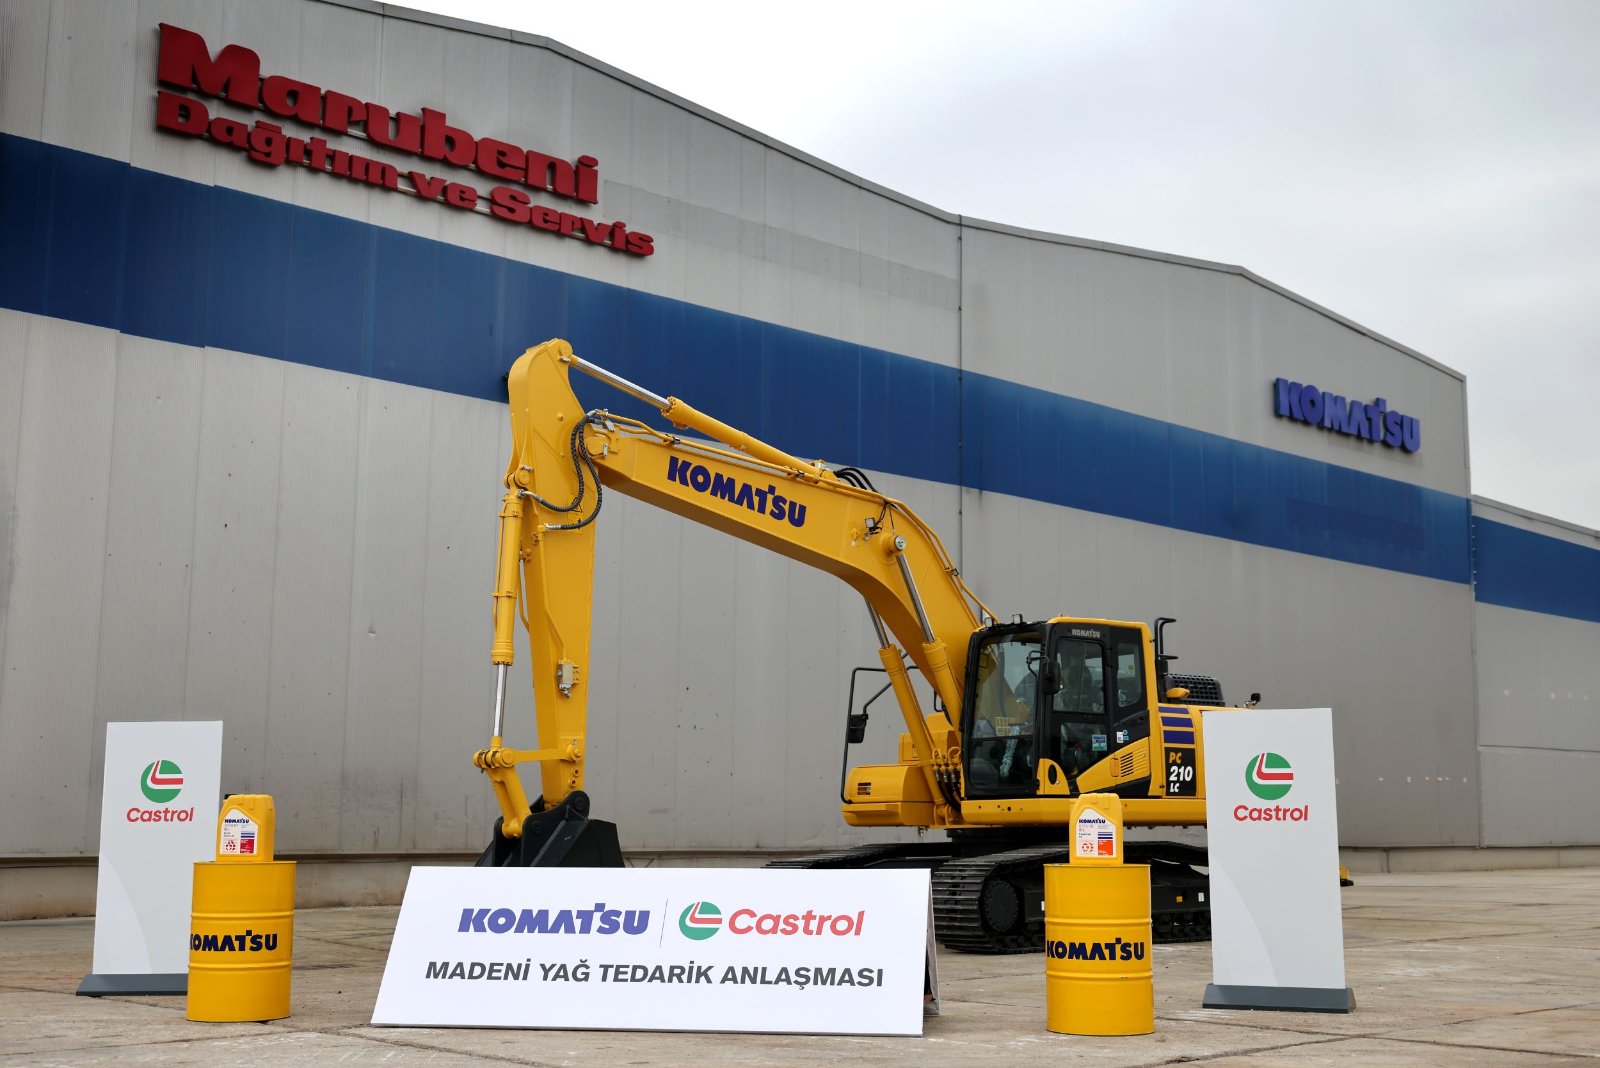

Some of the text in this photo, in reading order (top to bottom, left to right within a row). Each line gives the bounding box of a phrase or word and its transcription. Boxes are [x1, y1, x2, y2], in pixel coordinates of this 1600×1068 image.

[158, 23, 599, 204] Marubeni
[157, 90, 655, 256] Dağıtım ve Servis
[1274, 378, 1421, 453] KOMATSU
[667, 455, 807, 528] KOMATSU
[1072, 629, 1100, 638] KOMATSU
[1169, 752, 1182, 764] PC
[1169, 766, 1193, 781] 210
[1170, 783, 1180, 792] LC
[127, 807, 195, 822] Castrol
[1233, 805, 1309, 821] Castrol
[458, 903, 865, 936] KOMATSU Castrol
[1047, 938, 1144, 960] KOMATSU
[425, 959, 883, 990] MADENİ YAĞ TEDARİK ANLAŞMASI
